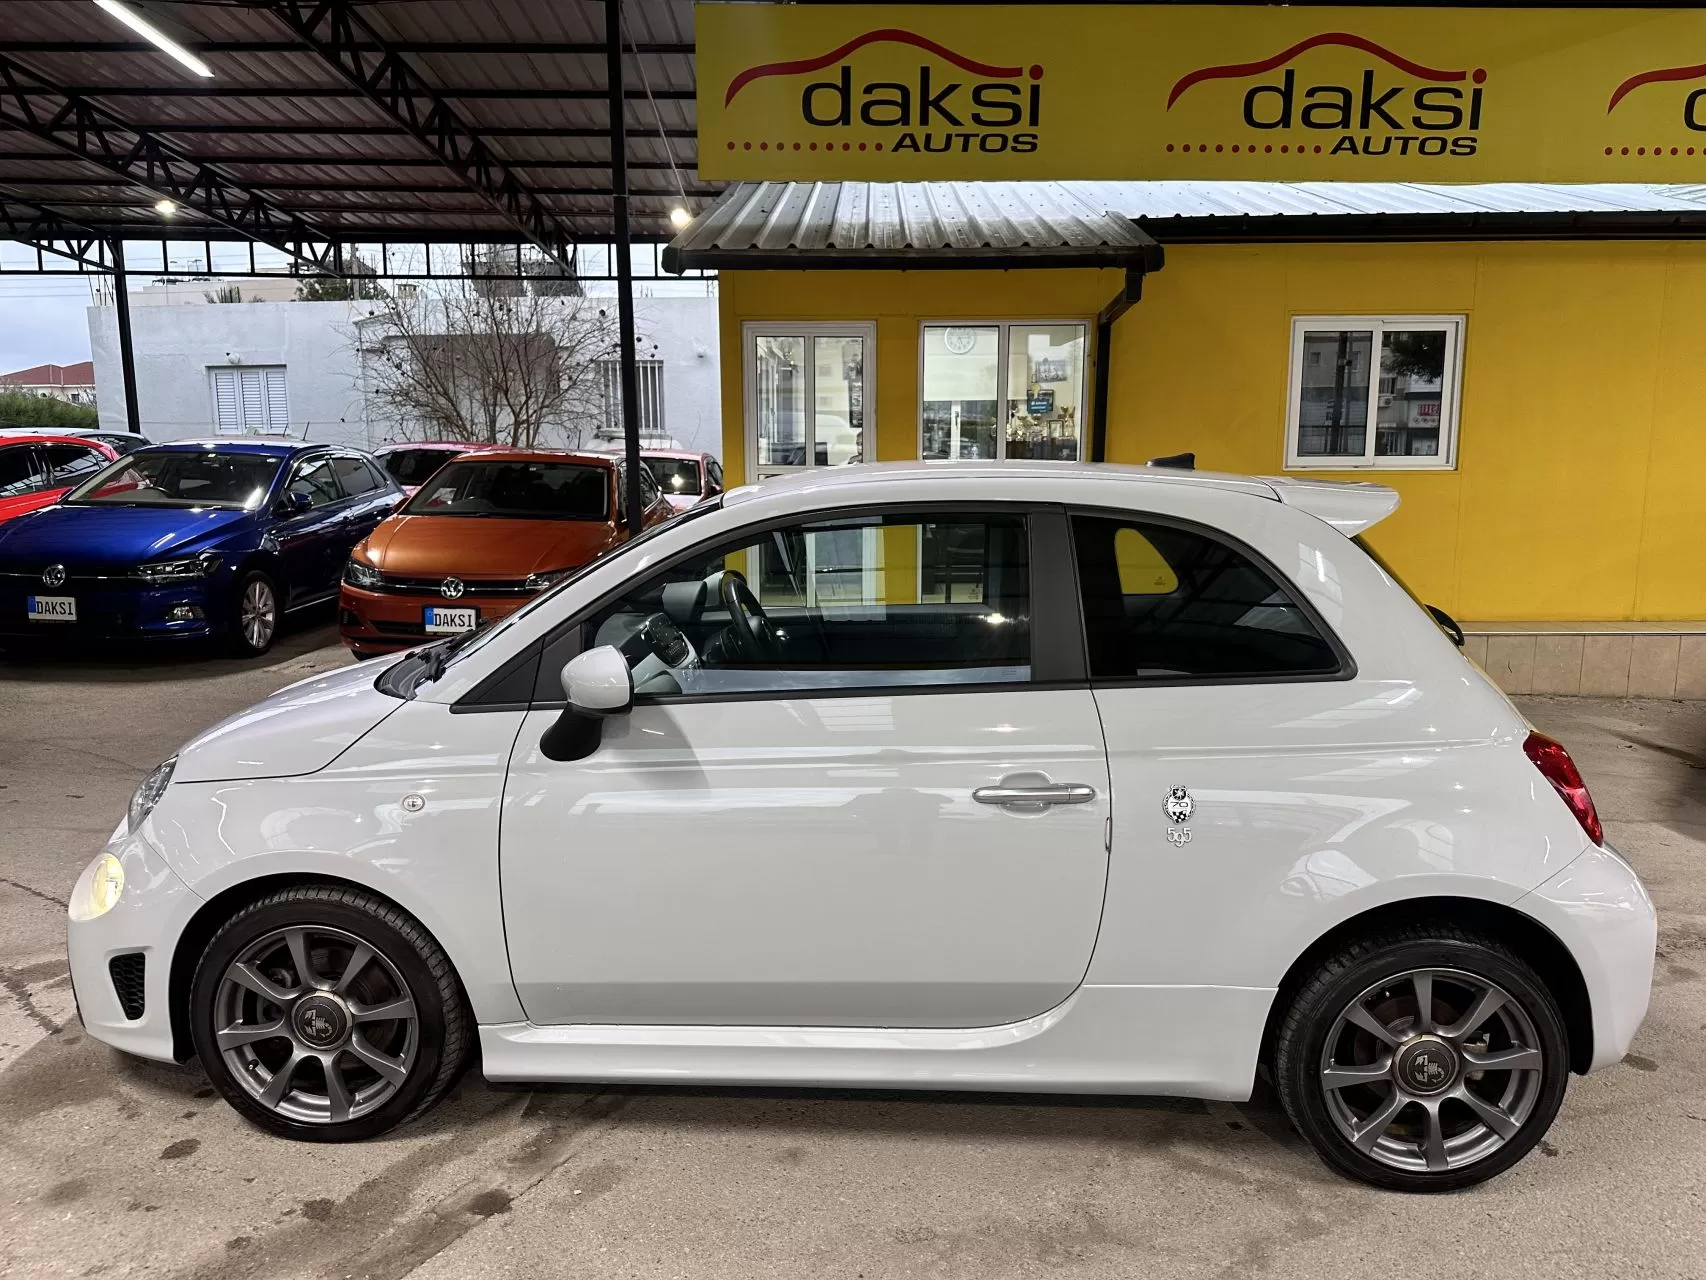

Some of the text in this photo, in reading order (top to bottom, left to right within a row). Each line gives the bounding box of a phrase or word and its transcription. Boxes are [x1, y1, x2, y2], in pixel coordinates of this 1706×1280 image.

[802, 64, 1044, 127] daksi
[1243, 67, 1487, 131] daksi
[890, 132, 1039, 153] AUTOS
[1329, 135, 1478, 156] AUTOS
[37, 600, 74, 615] DAKSI
[434, 613, 473, 628] DAKSI
[1166, 827, 1192, 848] 595
